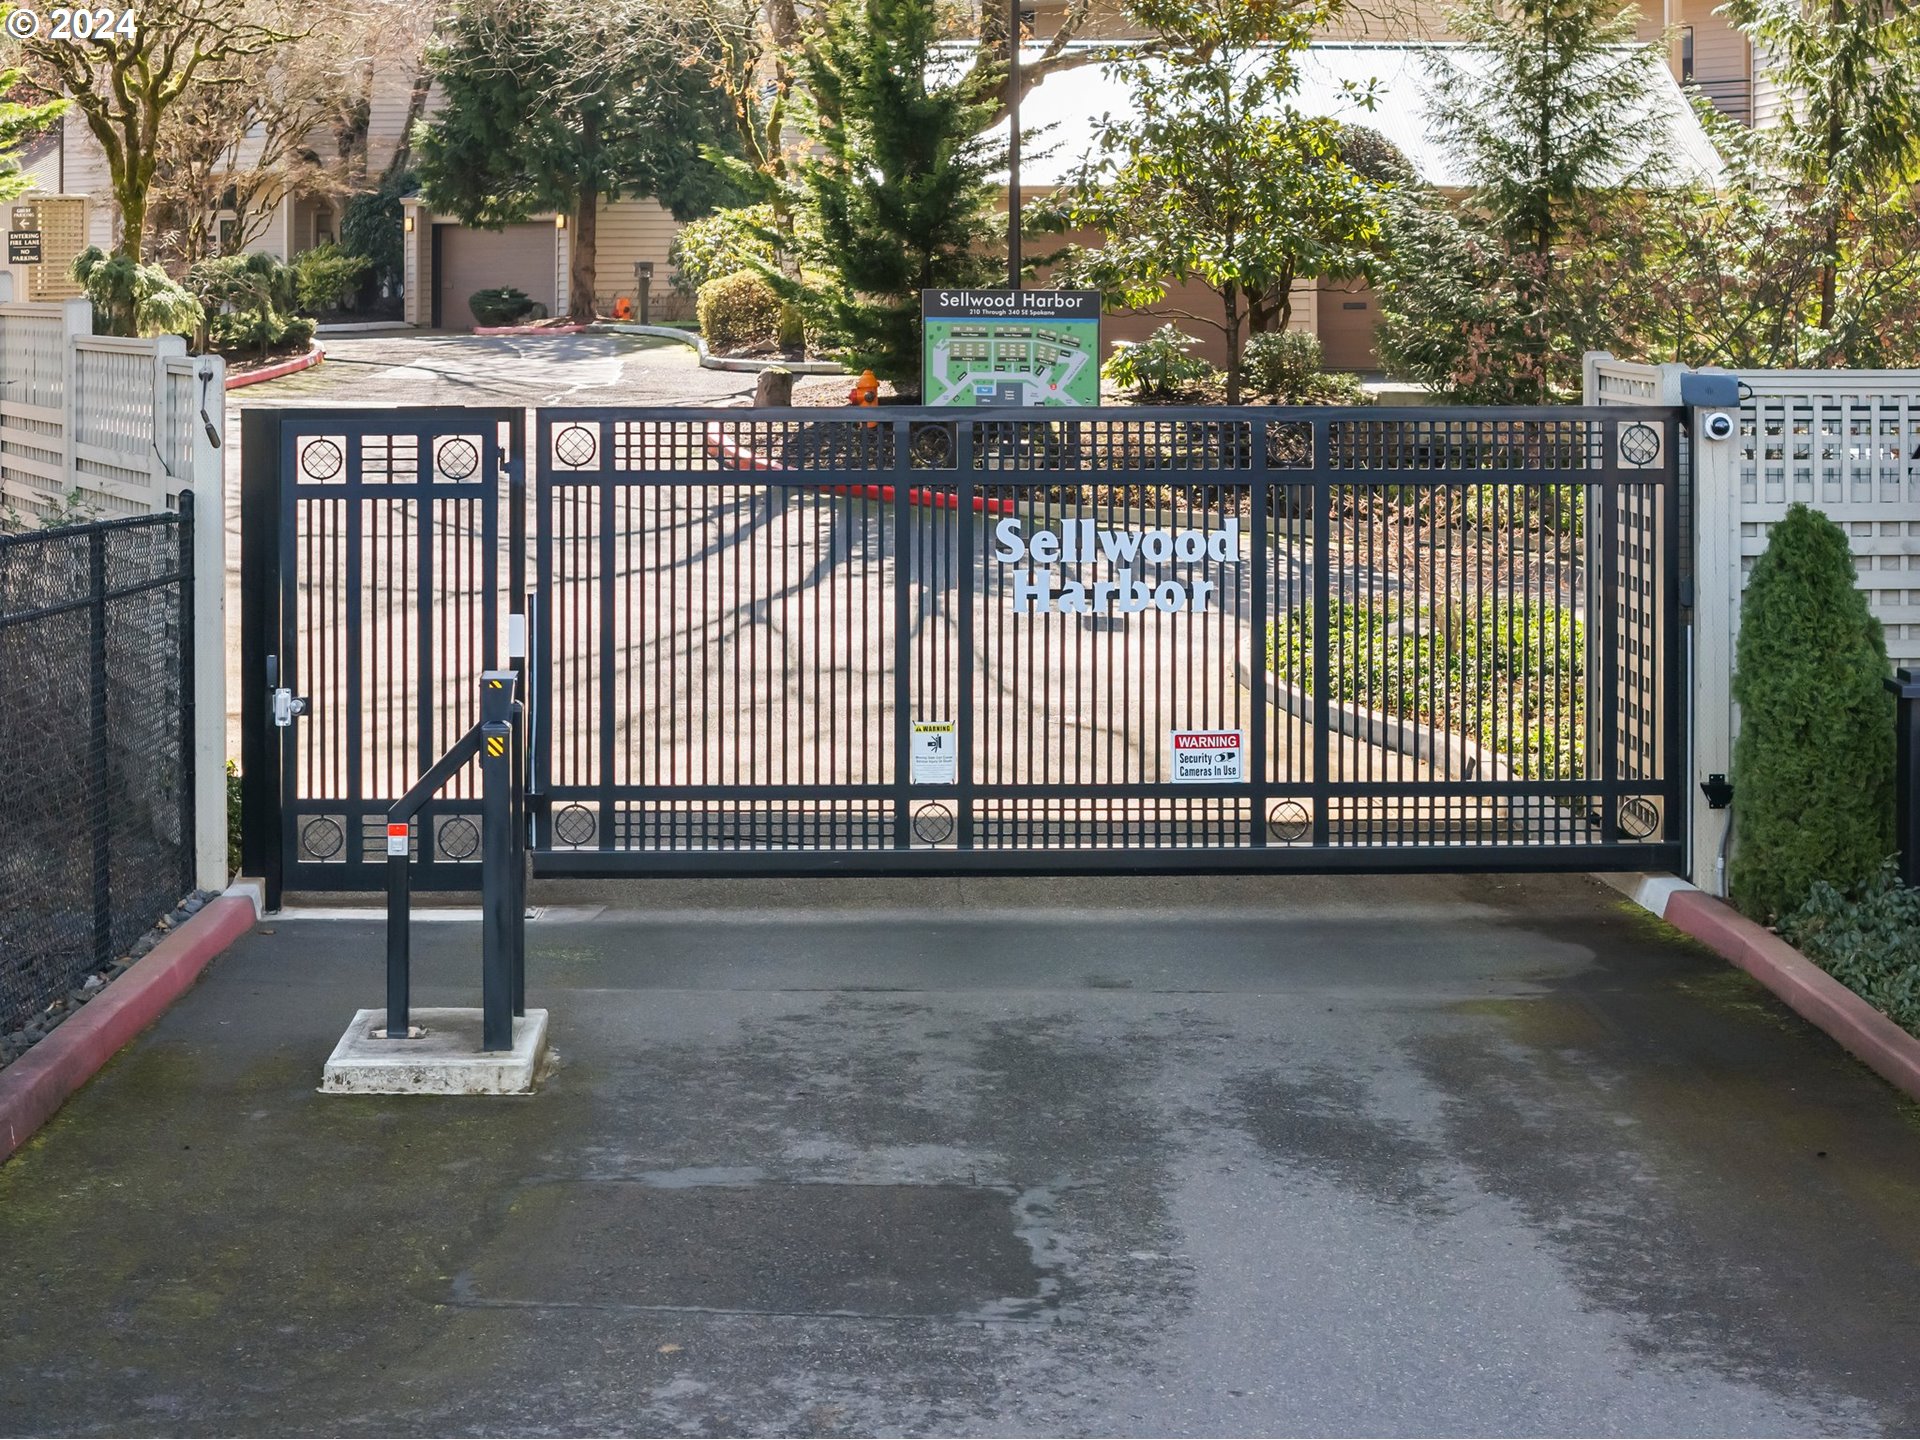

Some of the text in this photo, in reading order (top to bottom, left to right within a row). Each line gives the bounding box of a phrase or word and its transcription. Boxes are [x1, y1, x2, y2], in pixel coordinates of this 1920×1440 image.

[939, 292, 1083, 308] Sellwood Harbor
[982, 308, 1007, 316] Through
[995, 517, 1240, 563] Sellwood
[1013, 568, 1214, 613] Harbor
[1178, 736, 1237, 748] WARNING
[1179, 752, 1212, 765] Security
[1179, 765, 1236, 776] Cameras In Use
